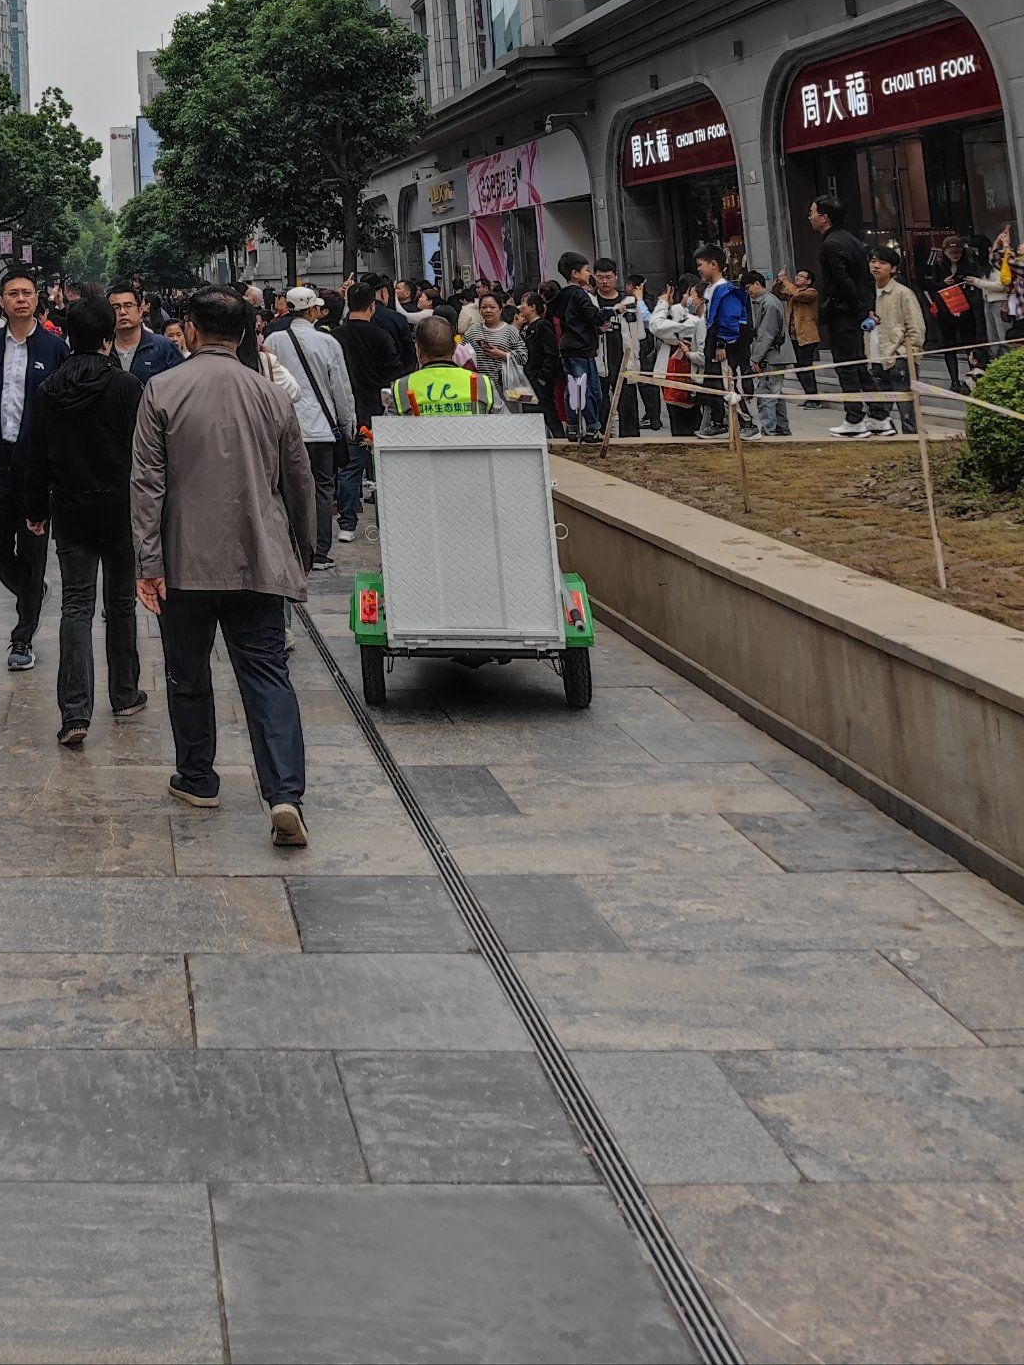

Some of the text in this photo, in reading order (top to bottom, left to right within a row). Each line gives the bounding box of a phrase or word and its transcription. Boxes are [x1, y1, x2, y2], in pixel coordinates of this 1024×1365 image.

[881, 55, 976, 95] CHOW TAI FOOK
[802, 71, 868, 129] 周大福
[631, 128, 670, 168] 周大福
[676, 122, 726, 148] CHOW TAI FOOK
